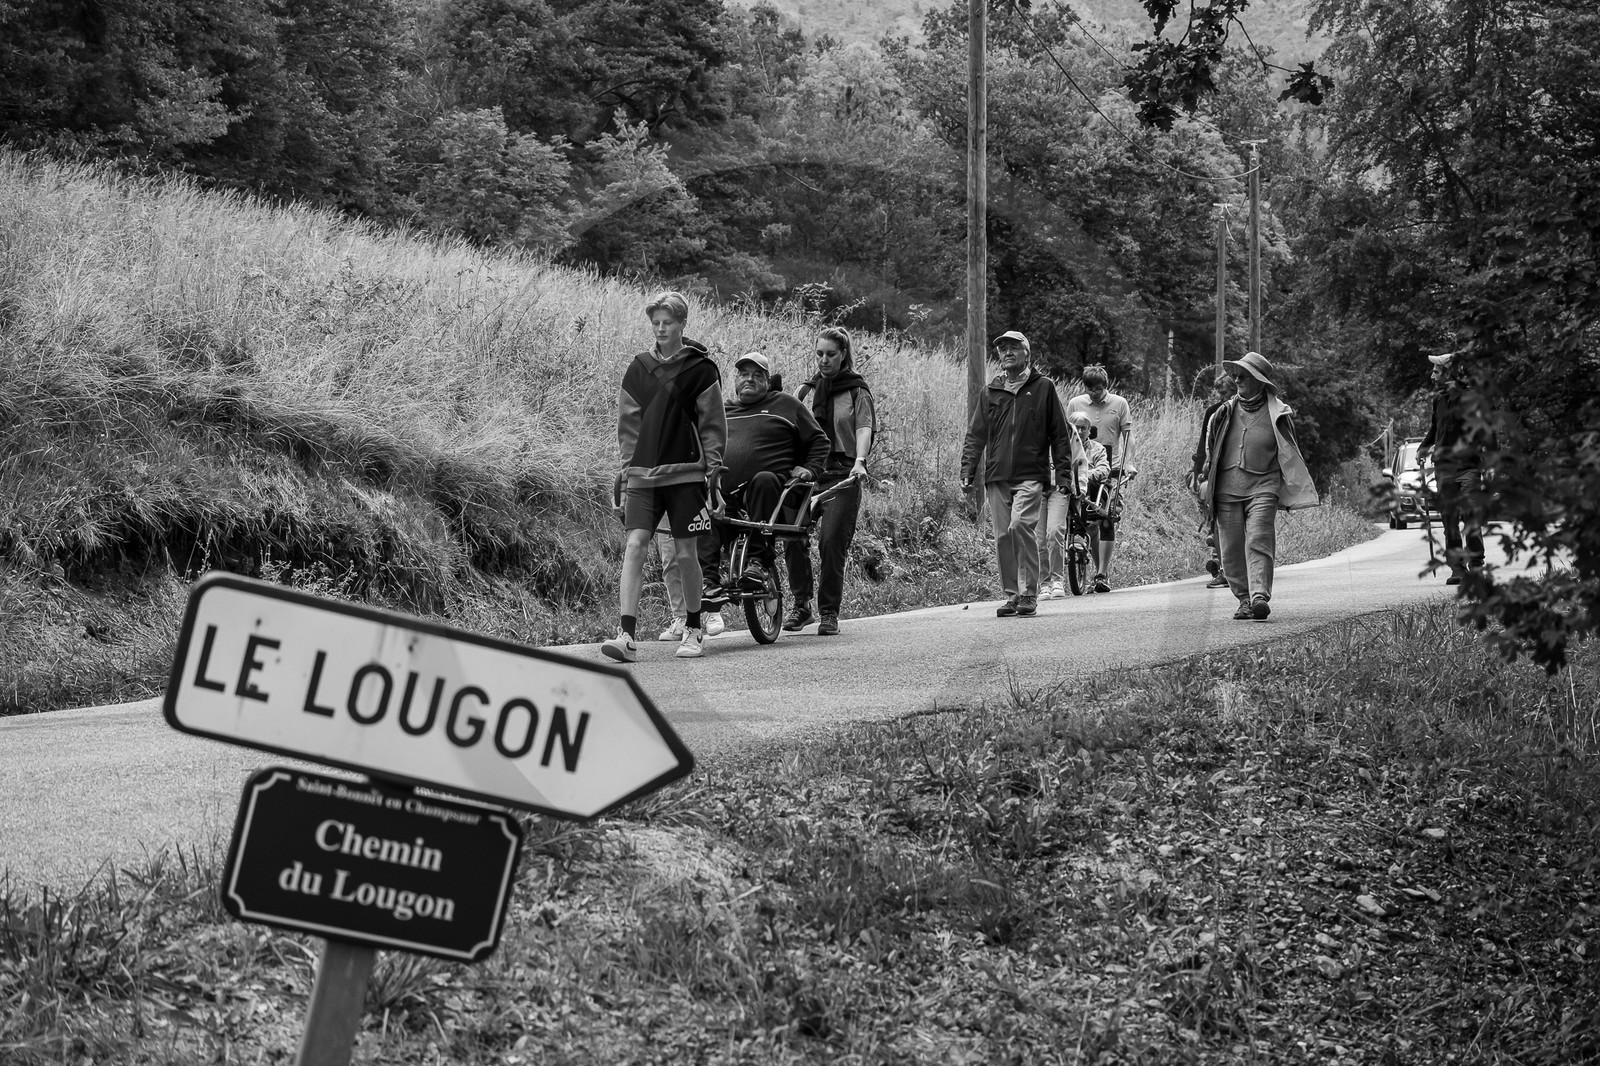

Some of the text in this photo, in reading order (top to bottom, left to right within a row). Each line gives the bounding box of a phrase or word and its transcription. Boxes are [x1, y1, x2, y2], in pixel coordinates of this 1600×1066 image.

[687, 519, 712, 532] adid
[193, 624, 591, 772] LE LOUGON
[385, 797, 402, 811] en
[404, 799, 482, 825] Champsaur
[315, 820, 443, 872] Chemin
[278, 861, 455, 921] du Lougon
